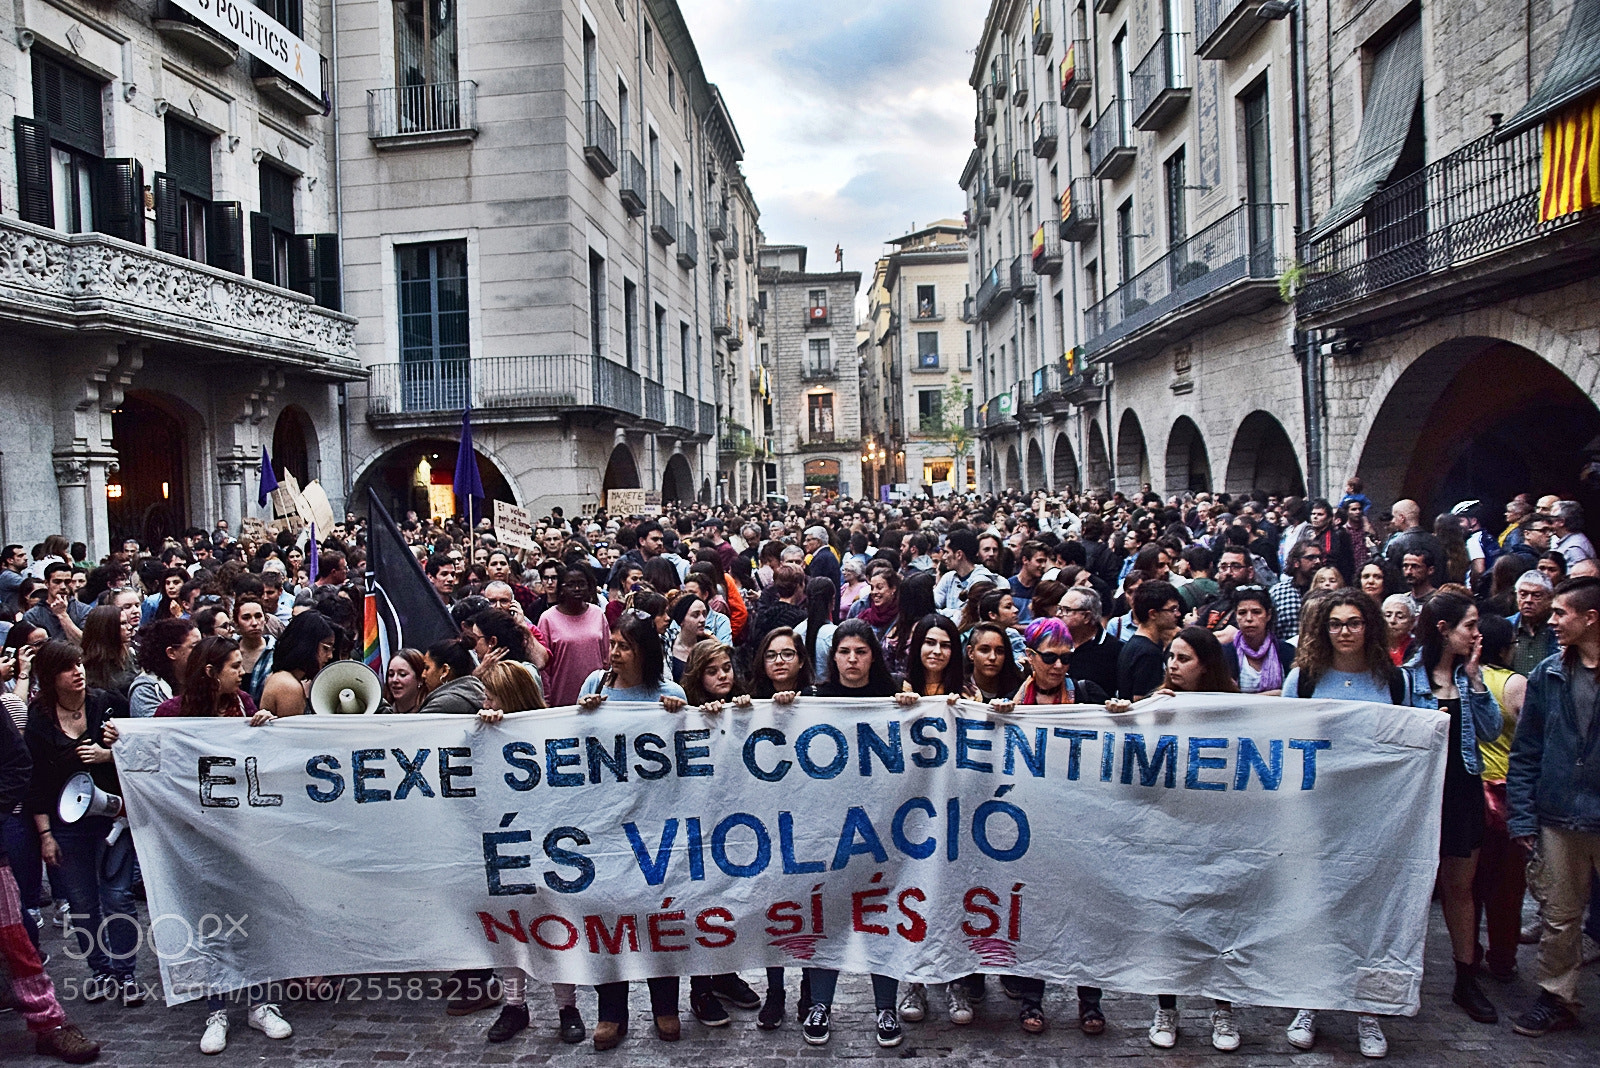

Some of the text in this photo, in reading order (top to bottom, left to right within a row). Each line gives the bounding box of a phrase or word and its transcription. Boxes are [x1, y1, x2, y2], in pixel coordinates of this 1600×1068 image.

[611, 491, 644, 500] MACHETE
[611, 504, 645, 514] MACHOTE
[198, 716, 1332, 808] EL SEXE SENSE CONSENTIMENT
[482, 784, 1032, 897] ÉS VIOLACIÓ
[475, 871, 1027, 955] NOMÉS SÍ ÉS SÍ
